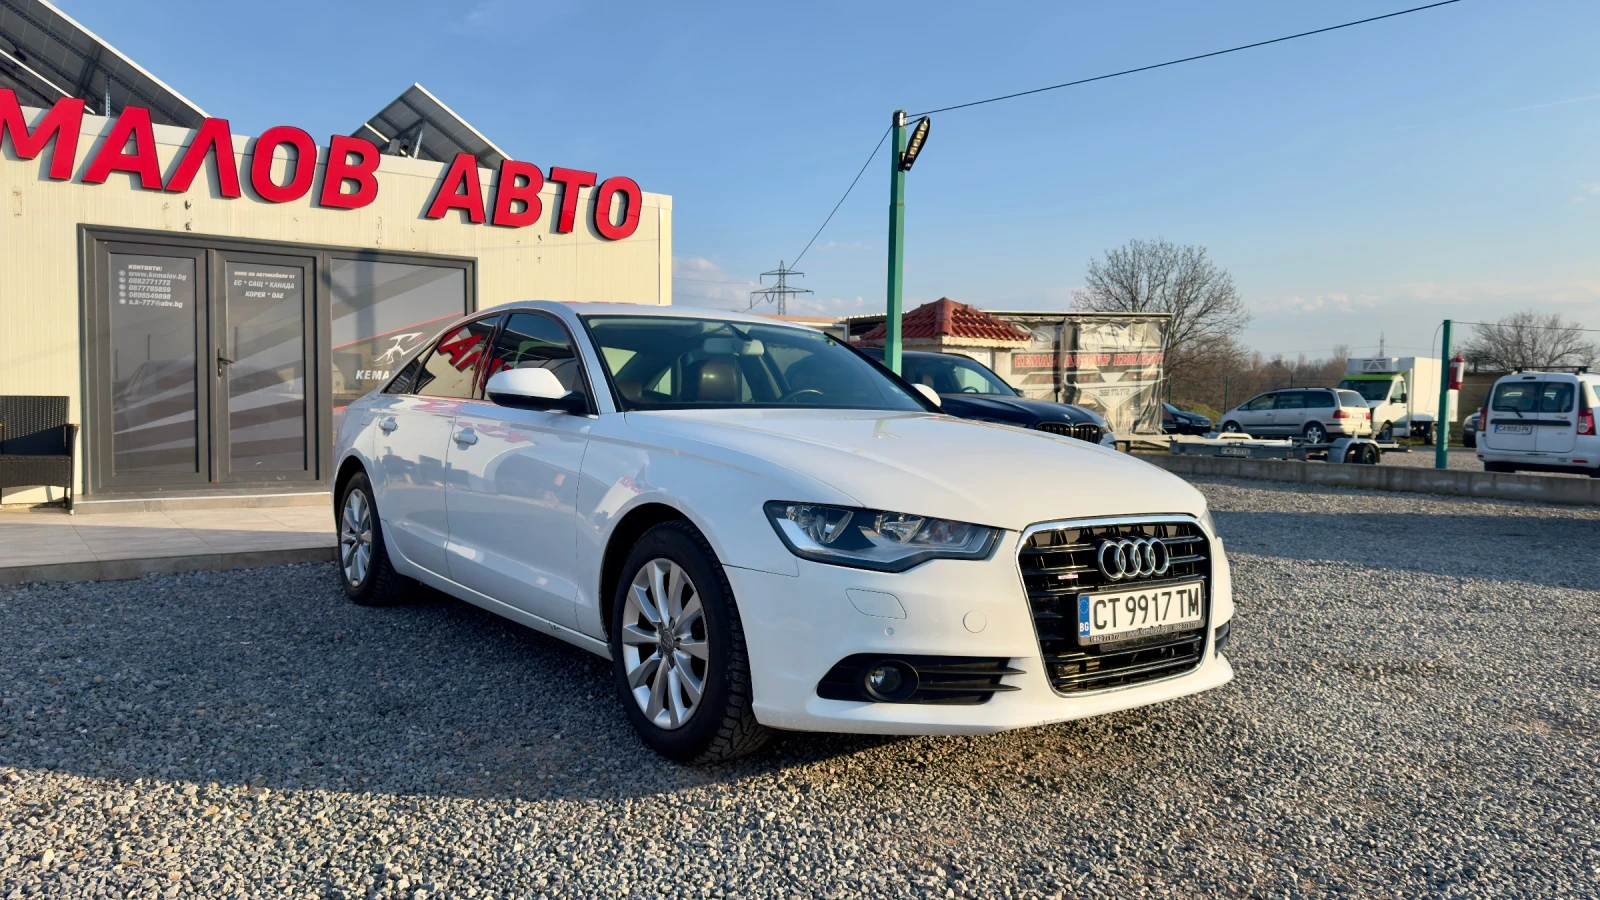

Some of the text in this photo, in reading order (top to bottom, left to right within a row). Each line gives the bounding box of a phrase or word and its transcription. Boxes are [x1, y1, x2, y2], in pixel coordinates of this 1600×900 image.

[426, 152, 643, 240] АВТО
[128, 277, 171, 286] 0882771772
[248, 280, 264, 288] САЩ
[269, 281, 295, 290] КАНАДА
[245, 290, 266, 298] КОРЕЯ
[355, 369, 395, 381] KEMA
[1125, 591, 1172, 627] 9917
[1079, 621, 1090, 632] BG
